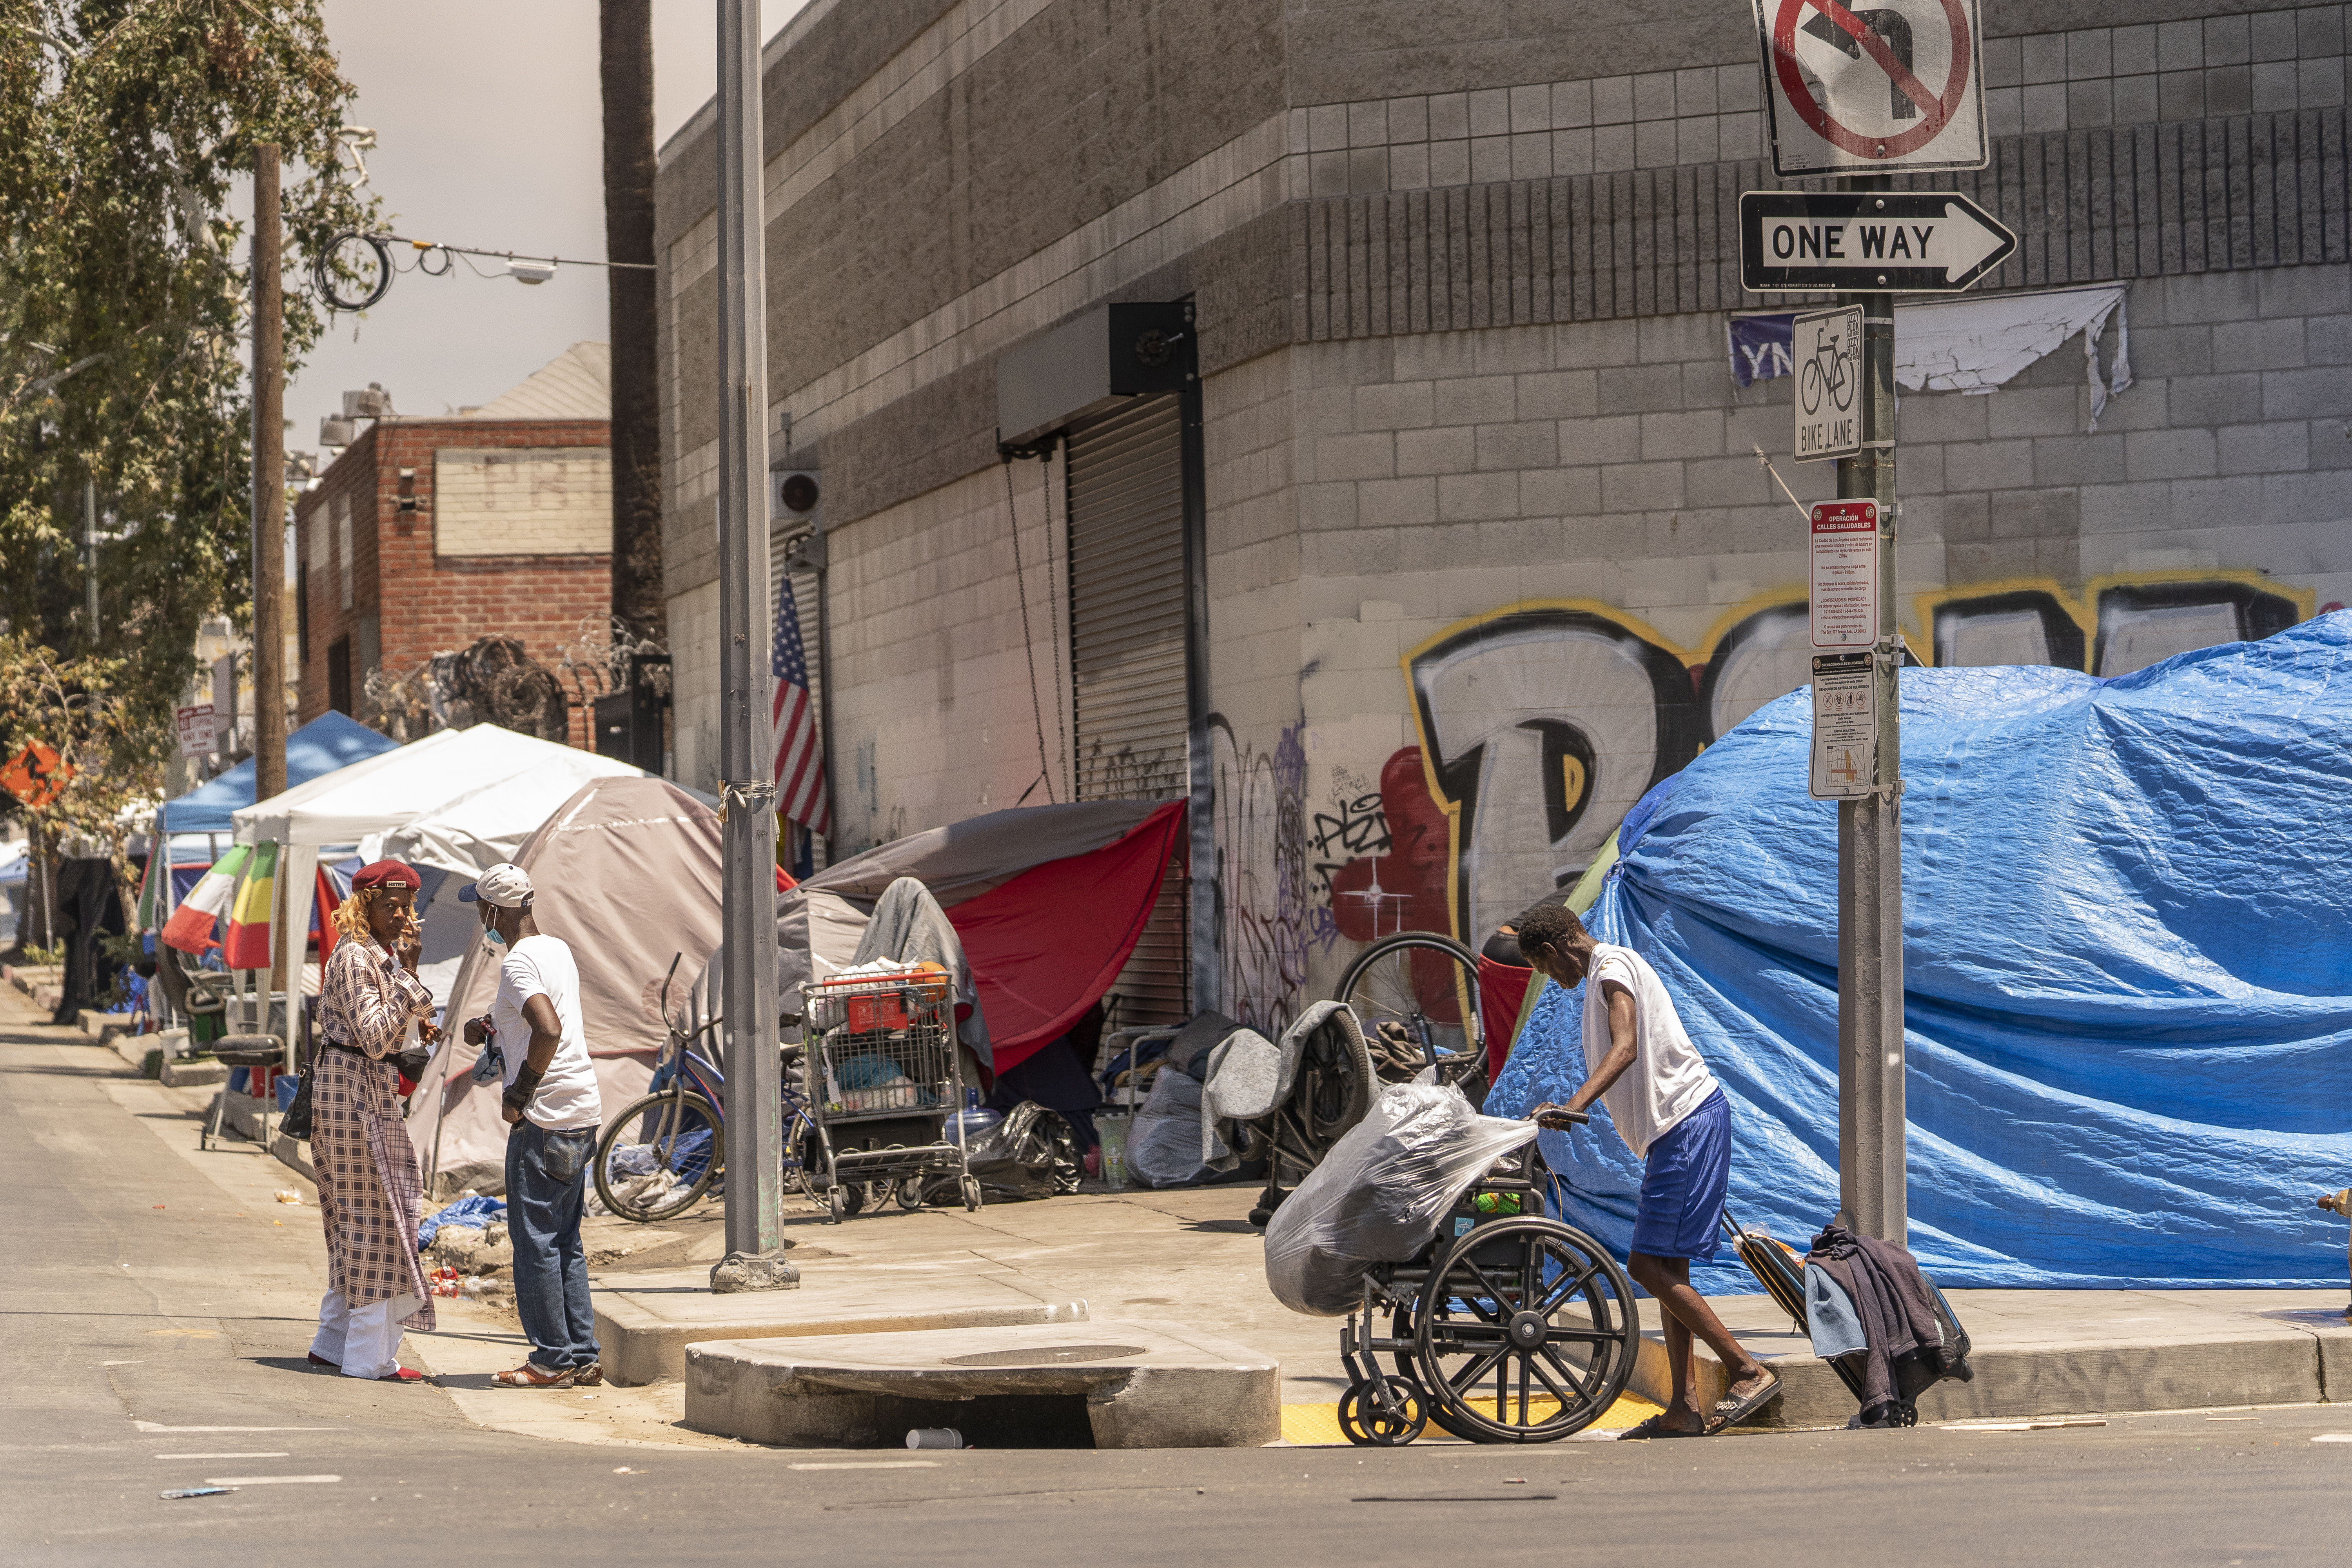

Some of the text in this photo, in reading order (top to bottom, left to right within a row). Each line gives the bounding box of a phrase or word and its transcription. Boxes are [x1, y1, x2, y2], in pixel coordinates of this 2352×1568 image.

[1772, 225, 1934, 259] ONE WAY
[1847, 312, 1858, 324] OZZY
[1847, 322, 1859, 333] PLOK
[1847, 336, 1859, 348] OZZY
[1847, 346, 1859, 357] PLOK
[1802, 423, 1822, 452] BIKE
[1828, 419, 1852, 448] LANE
[1829, 514, 1858, 522] OPERACIÓN
